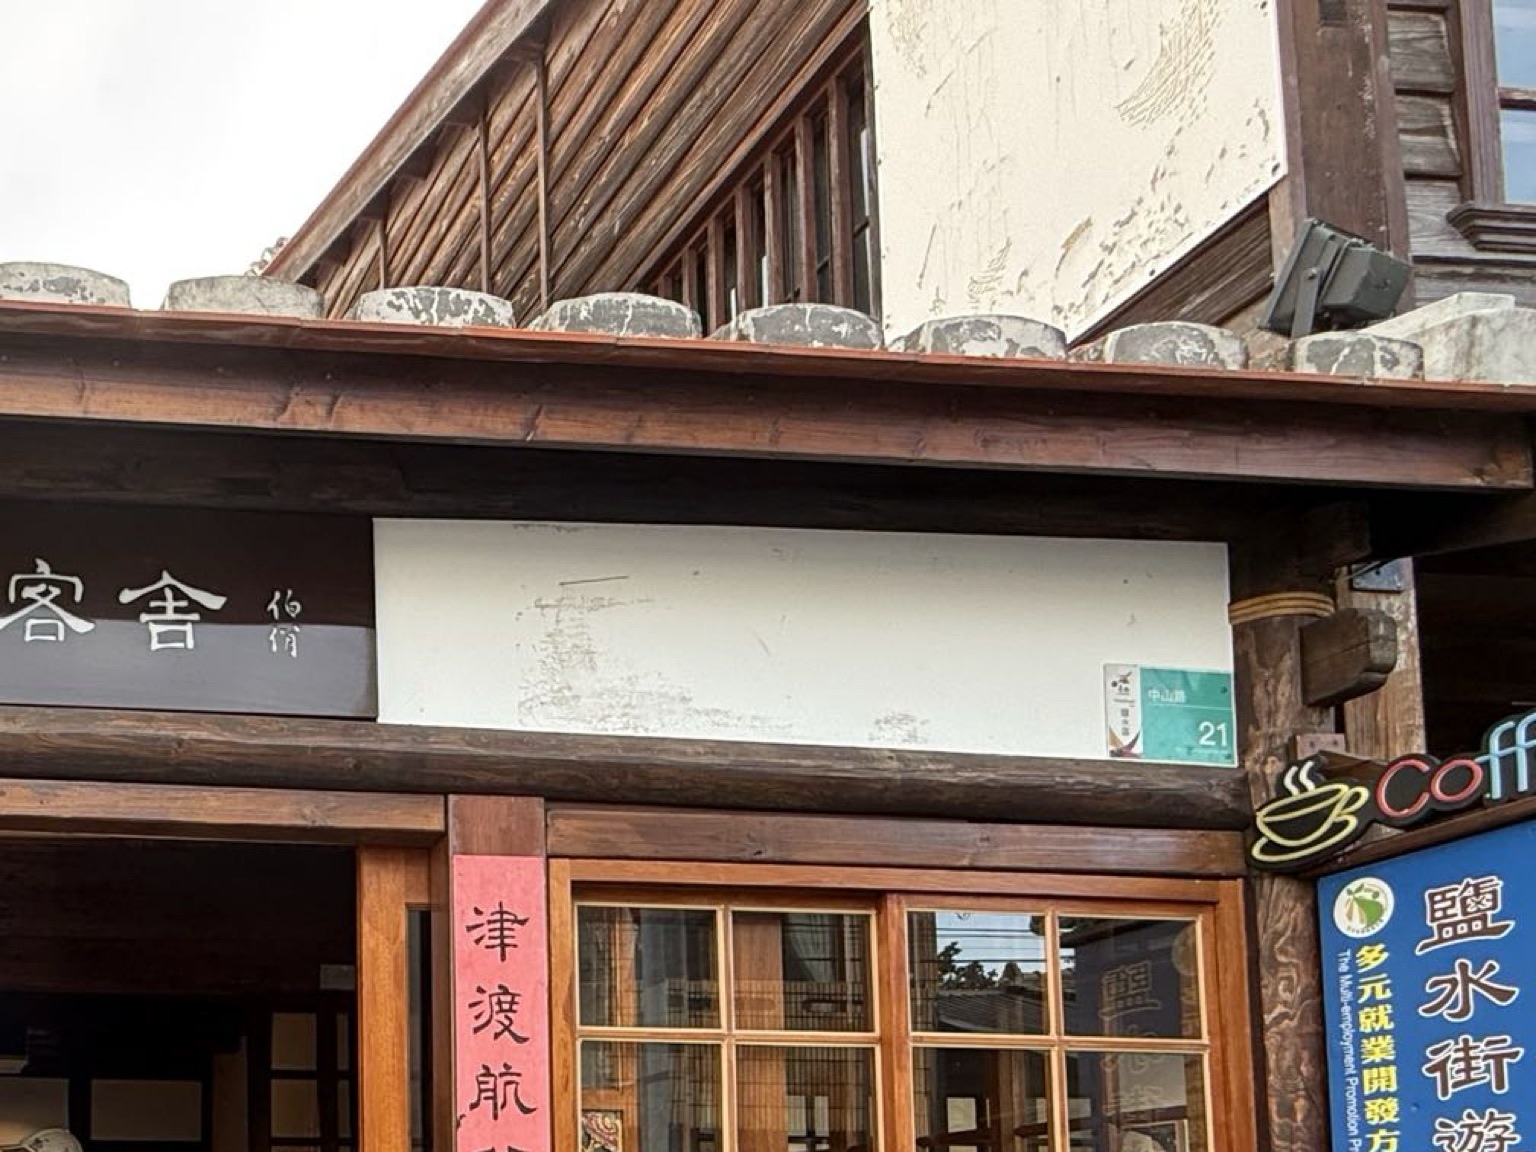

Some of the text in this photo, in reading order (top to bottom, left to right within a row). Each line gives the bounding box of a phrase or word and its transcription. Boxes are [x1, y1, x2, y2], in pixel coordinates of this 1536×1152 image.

[1198, 721, 1228, 747] 21
[1336, 949, 1351, 973] The
[1338, 974, 1355, 1076] Multi-employment
[1346, 1077, 1360, 1136] Promotion
